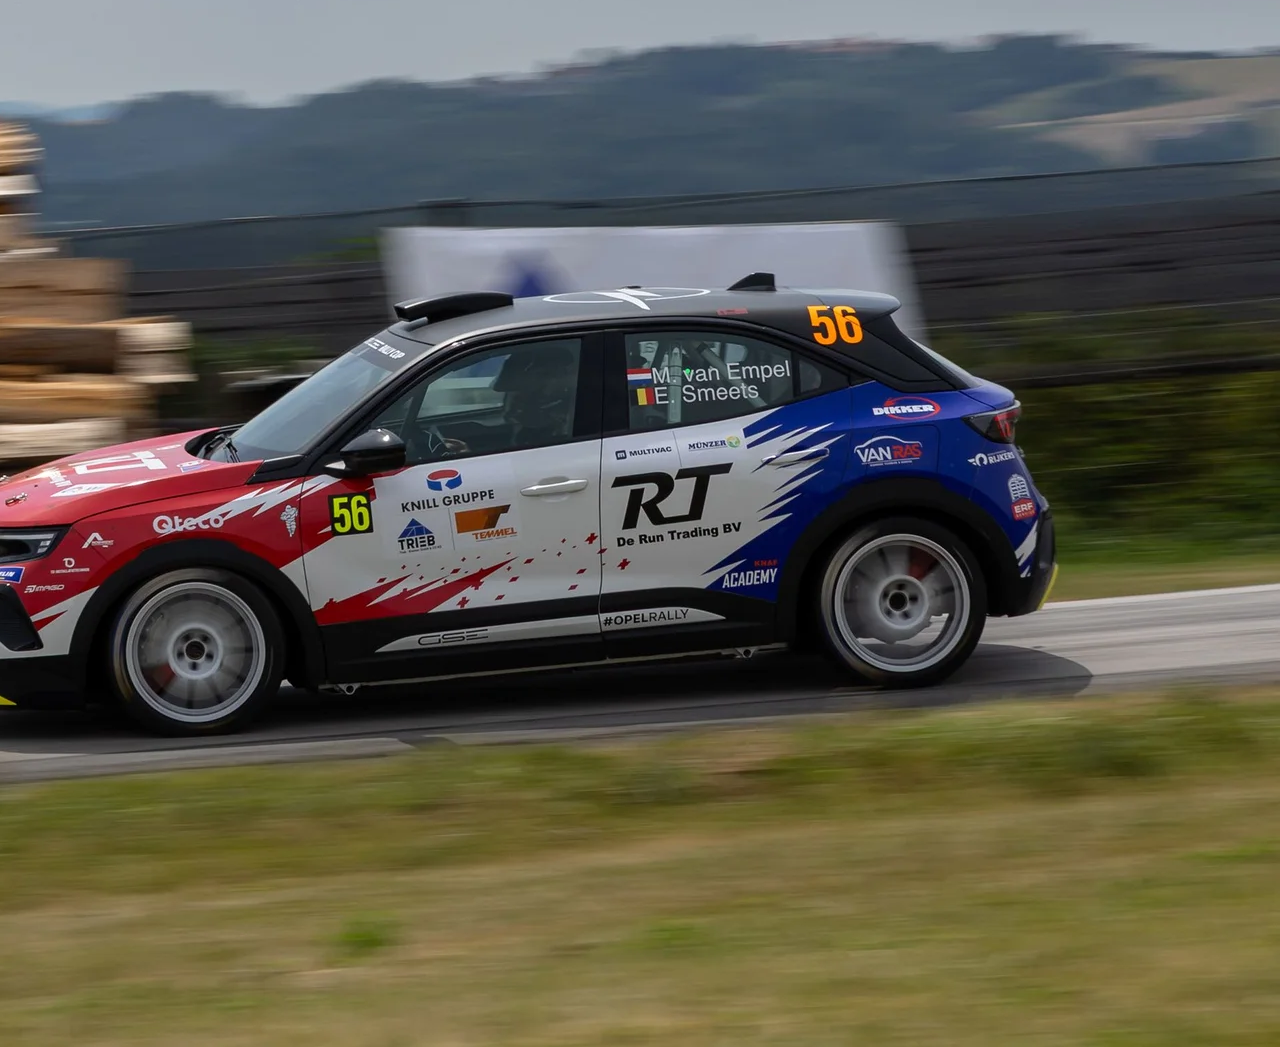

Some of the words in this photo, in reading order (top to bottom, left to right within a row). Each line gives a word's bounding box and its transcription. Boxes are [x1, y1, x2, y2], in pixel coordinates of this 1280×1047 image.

[807, 305, 864, 346] 56
[651, 366, 677, 385] M.
[683, 366, 720, 383] van
[726, 359, 791, 383] Empel
[654, 386, 675, 405] E.
[682, 384, 759, 404] Smeets
[872, 404, 936, 416] DIKKER
[629, 446, 672, 457] MULTIVAC
[688, 439, 727, 450] MÜNZER
[855, 445, 892, 463] VAN
[892, 443, 923, 460] RAS
[987, 451, 1016, 466] RIJKERS
[401, 498, 440, 513] KNILL
[442, 489, 495, 507] GRUPPE
[611, 462, 734, 531] RT
[332, 496, 372, 533] 56
[1013, 502, 1034, 514] ERF
[152, 515, 225, 535] Qteco
[472, 528, 518, 540] TEMMEL
[616, 537, 635, 548] De
[638, 533, 665, 545] Run
[668, 526, 719, 541] Trading
[723, 522, 742, 534] BV
[398, 535, 436, 551] TRIEB
[722, 568, 778, 589] ACADEMY
[603, 608, 690, 627] #OPELRALLY
[417, 628, 489, 646] GSE
